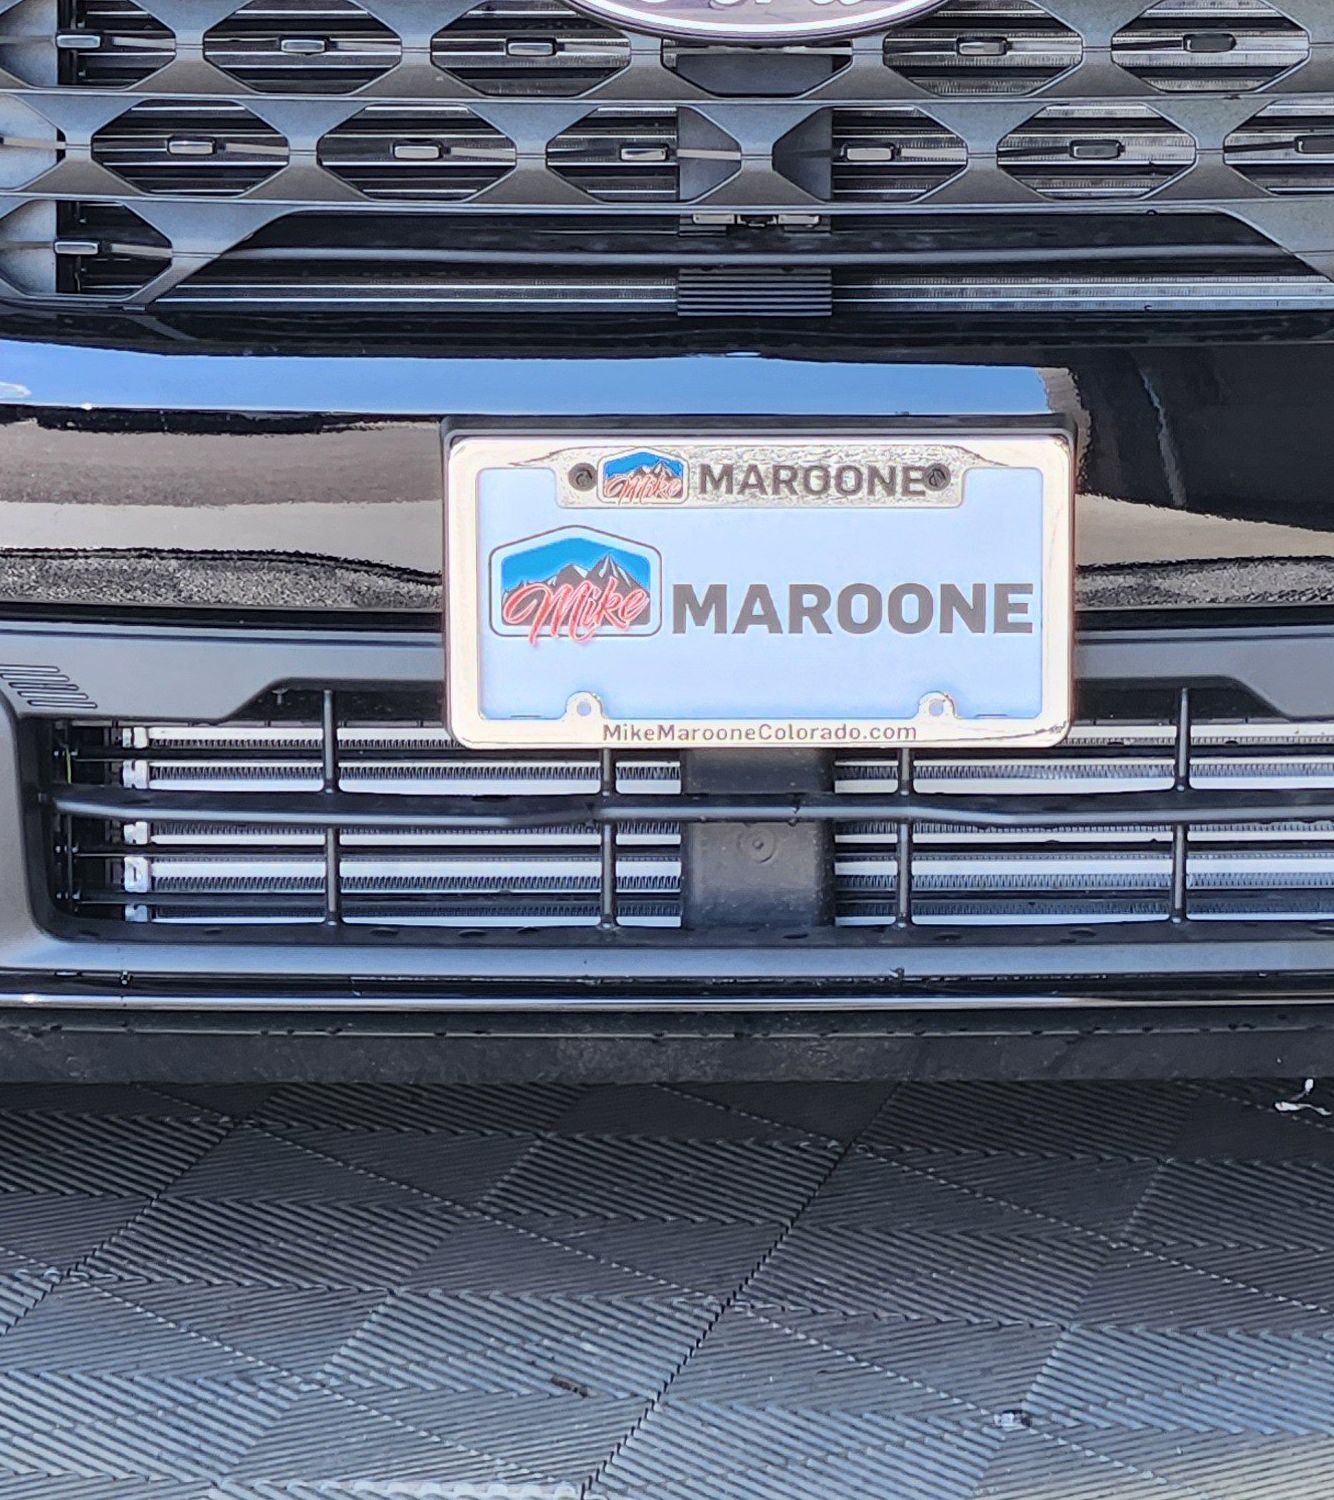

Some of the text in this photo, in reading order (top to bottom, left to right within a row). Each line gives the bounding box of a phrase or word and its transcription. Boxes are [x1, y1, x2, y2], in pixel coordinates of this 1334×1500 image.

[603, 463, 929, 504] Mike MAROONE
[501, 579, 1034, 648] Mike MAROONE
[603, 723, 917, 742] MikeMarooneColorado.com
